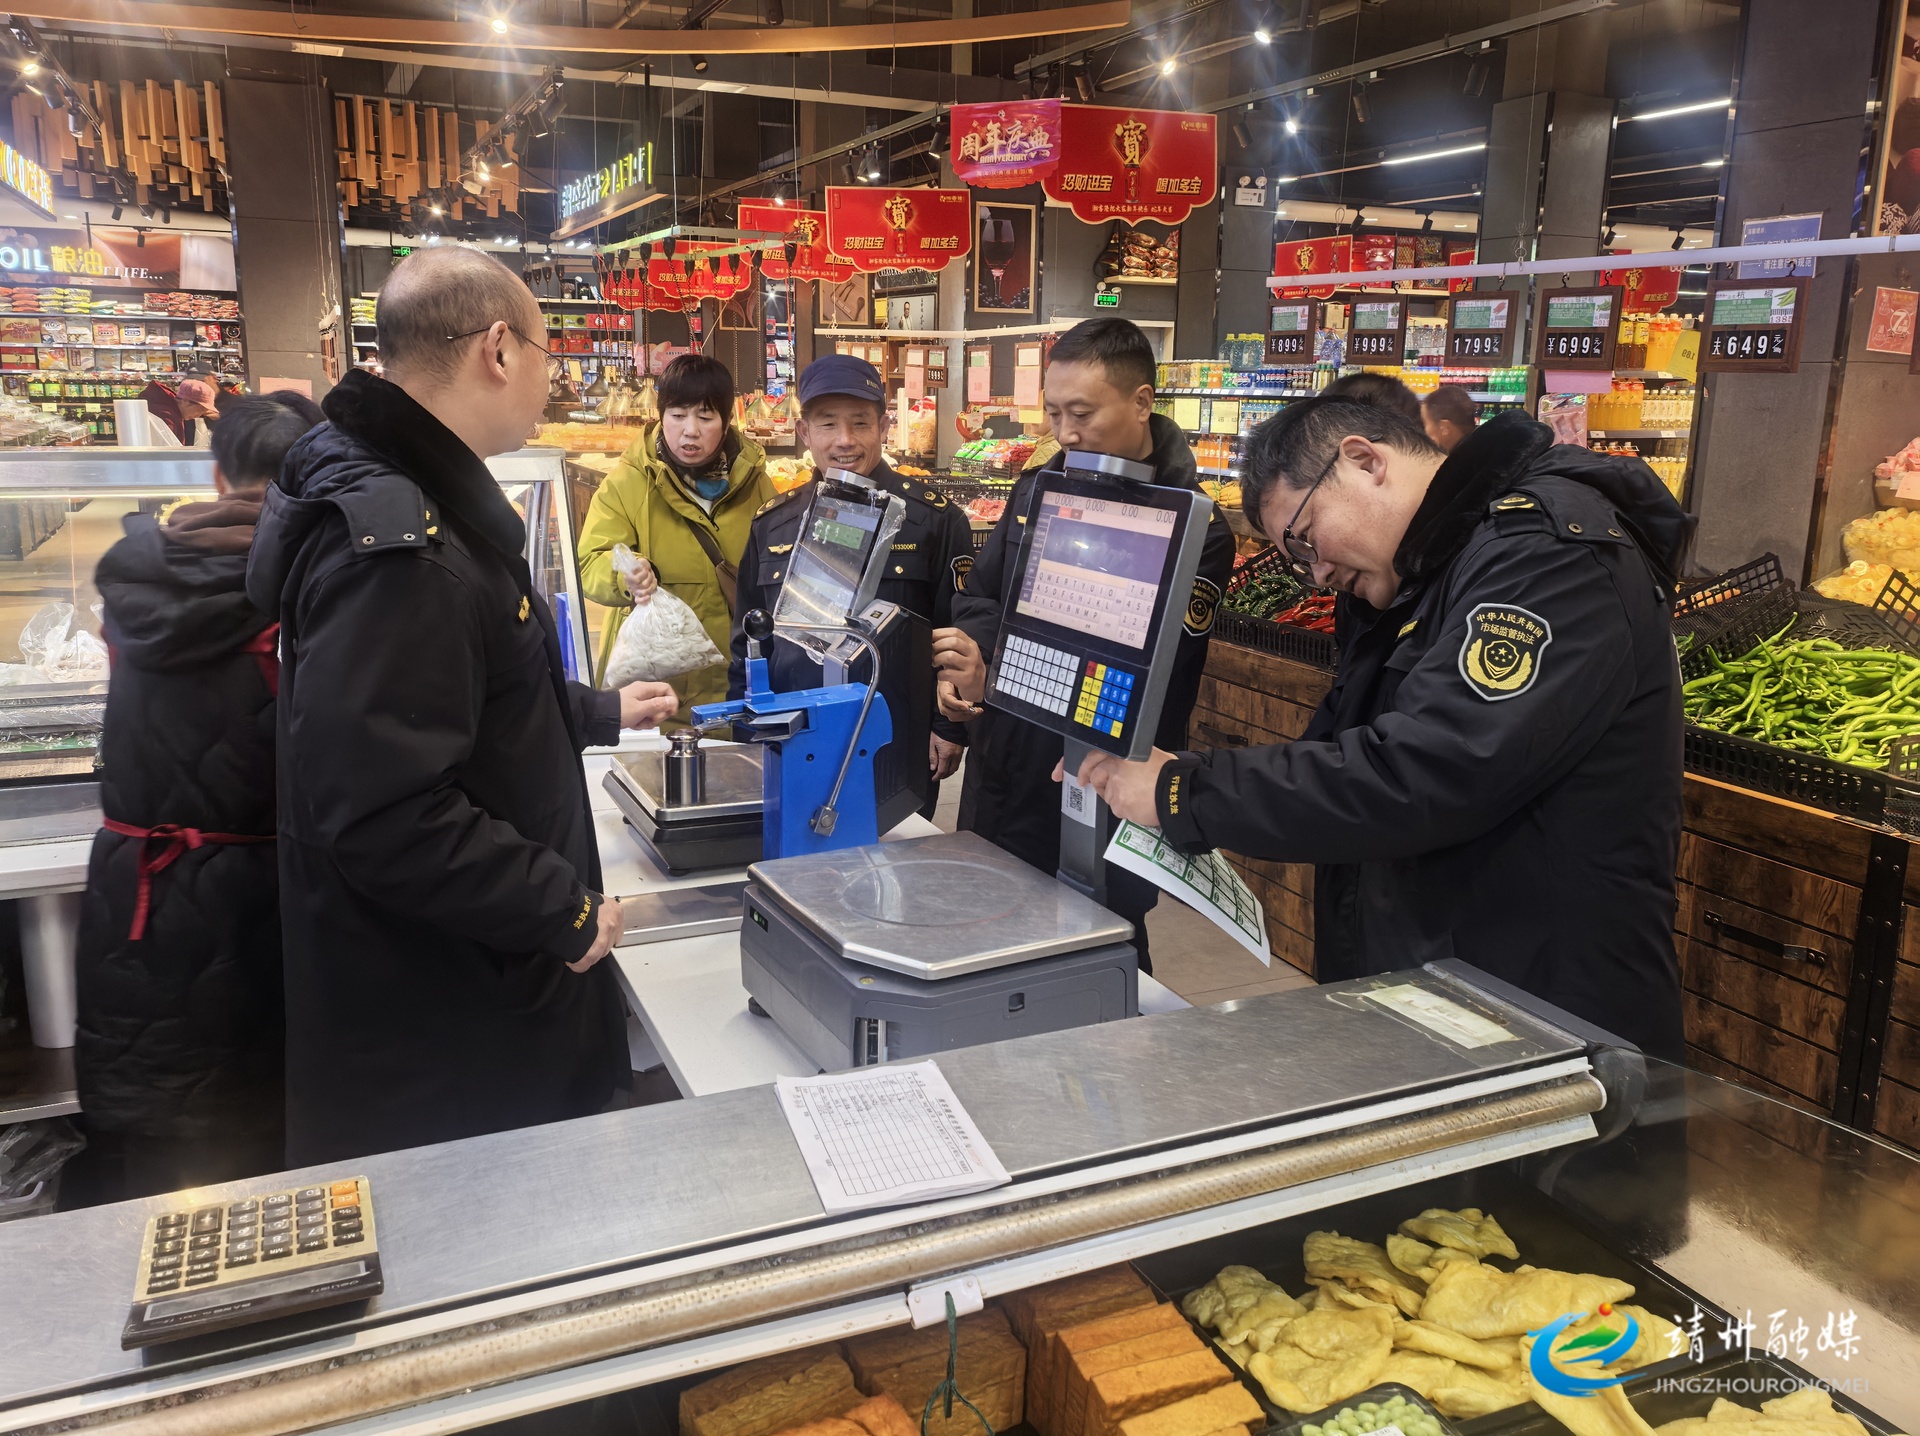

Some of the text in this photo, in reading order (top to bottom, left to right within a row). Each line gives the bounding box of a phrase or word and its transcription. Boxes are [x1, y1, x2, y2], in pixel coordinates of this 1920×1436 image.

[957, 119, 1053, 162] 周年庆典
[1061, 174, 1113, 192] 招财进宝
[1155, 176, 1202, 195] 喝加多宝
[844, 237, 885, 250] 招财进宝
[920, 235, 959, 250] 喝加多宝
[0, 245, 104, 276] OIL 粮油
[1054, 494, 1174, 524] 0.000 0.000 0.00 0.00
[1476, 612, 1544, 638] 中华人民共和国
[1480, 622, 1535, 646] 市场监管执法
